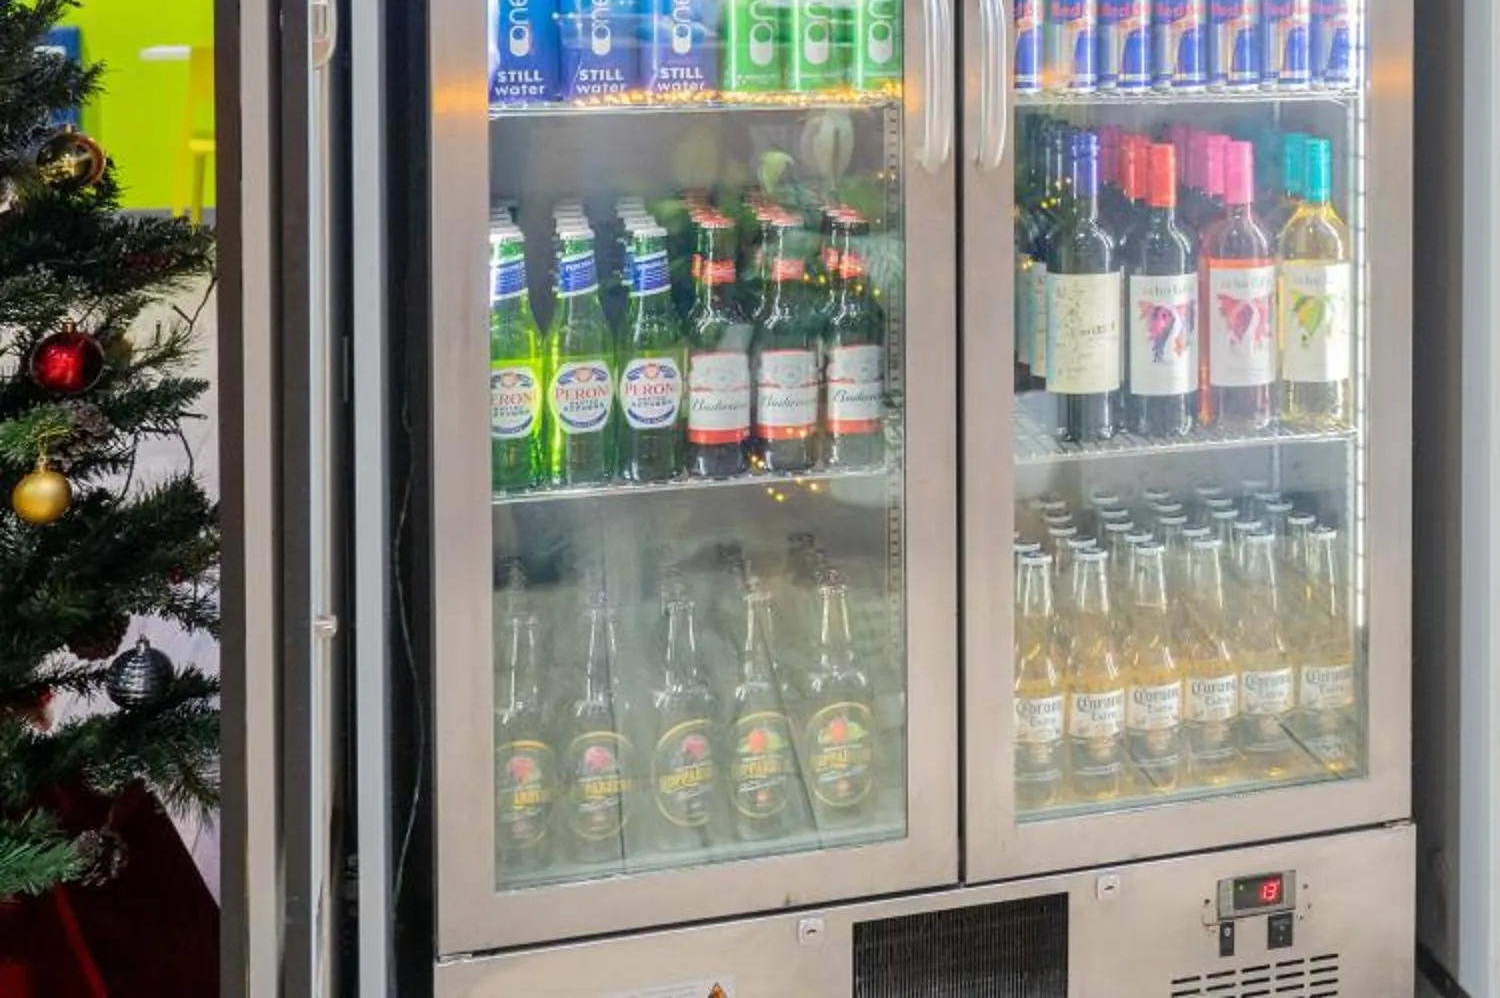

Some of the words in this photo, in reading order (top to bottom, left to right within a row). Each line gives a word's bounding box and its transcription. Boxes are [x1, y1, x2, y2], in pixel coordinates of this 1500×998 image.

[498, 71, 544, 83] STILL
[578, 69, 624, 81] STILL
[660, 67, 704, 79] STILL
[496, 83, 546, 96] water
